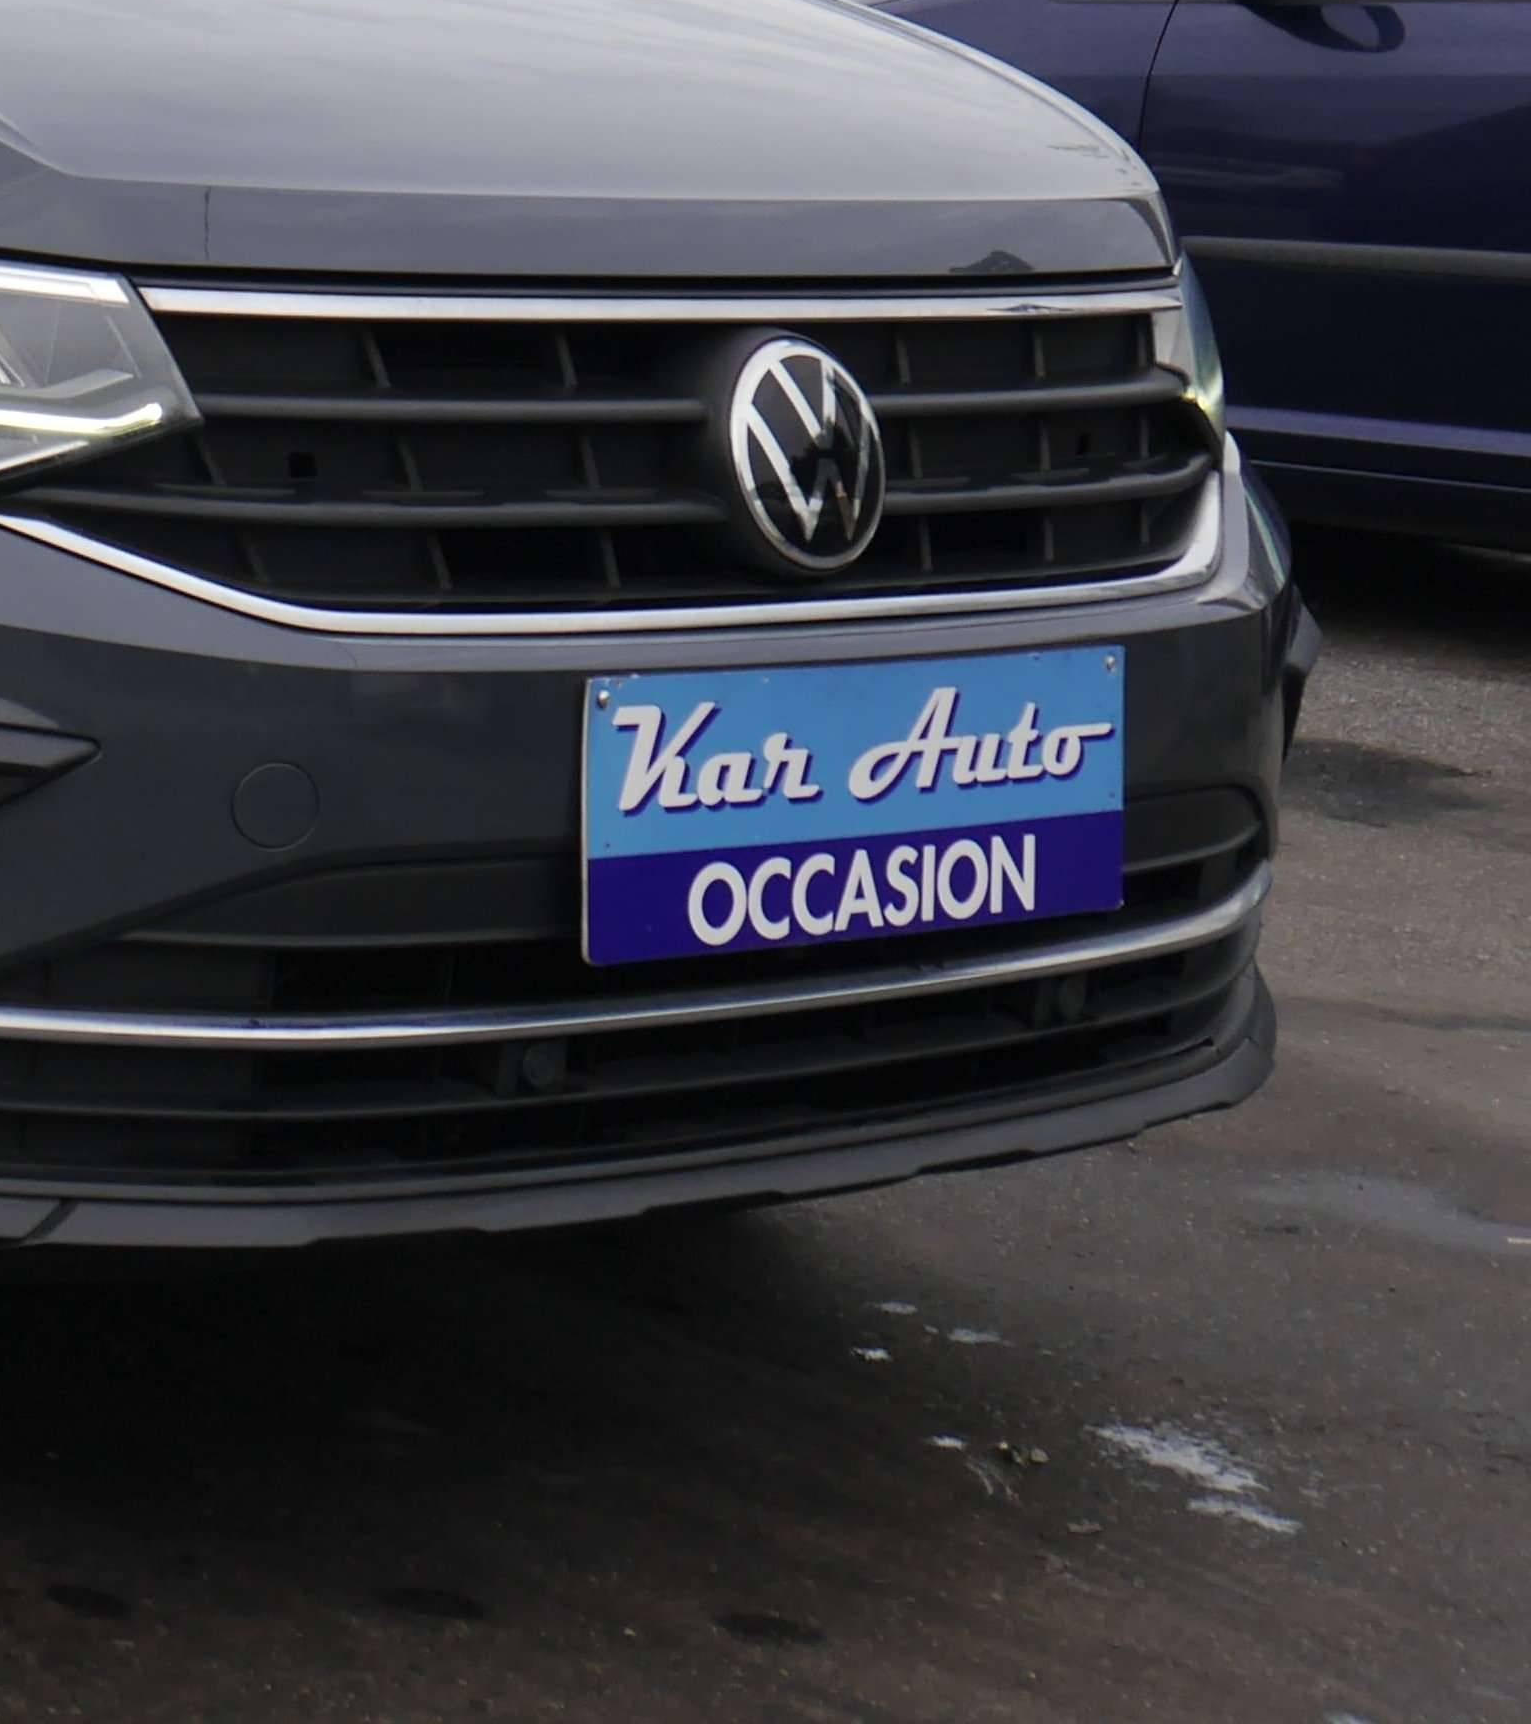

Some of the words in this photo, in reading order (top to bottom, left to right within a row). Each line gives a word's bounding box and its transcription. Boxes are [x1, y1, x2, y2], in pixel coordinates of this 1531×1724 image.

[612, 701, 825, 815] Kar
[847, 686, 1115, 802] Auto
[687, 833, 1038, 947] OCCASION
